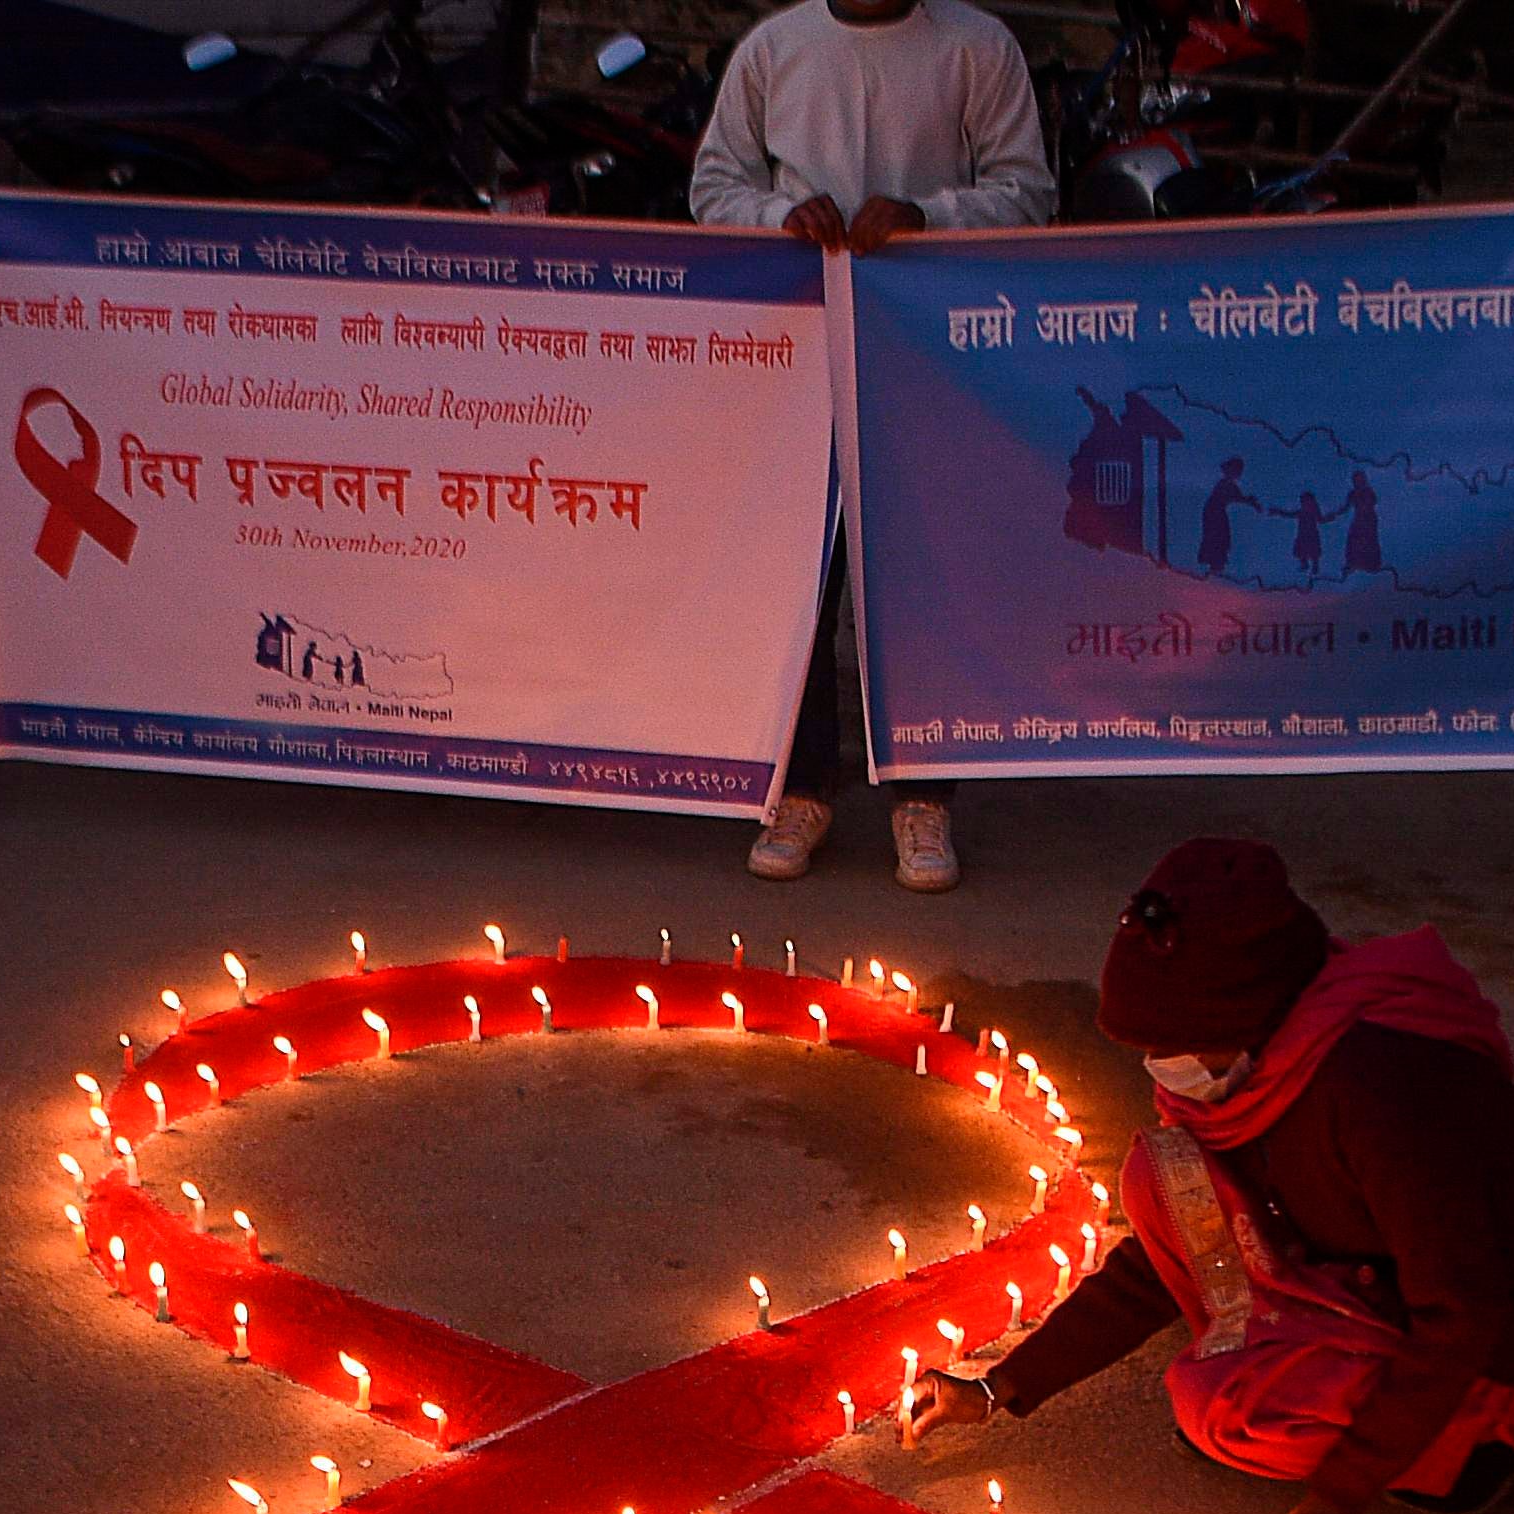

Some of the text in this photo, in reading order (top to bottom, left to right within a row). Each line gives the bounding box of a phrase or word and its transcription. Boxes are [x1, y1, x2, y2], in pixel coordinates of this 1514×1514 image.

[611, 260, 688, 292] समाज
[183, 308, 217, 336] तथा
[340, 312, 383, 346] लागि
[599, 332, 635, 362] तथा
[708, 331, 795, 370] जिम्मेवारी
[947, 291, 1017, 351] हाम्रो
[161, 374, 593, 436] Global Solidarity, Shared Responsibility
[119, 432, 203, 503] दिप
[438, 457, 649, 530] कार्यक्रम
[234, 524, 283, 548] 30th
[1066, 613, 1193, 662] माइती
[1216, 613, 1336, 657] नेपाल
[1391, 614, 1497, 652] Maiti
[368, 701, 405, 719] Maiti
[408, 705, 453, 724] Nepal
